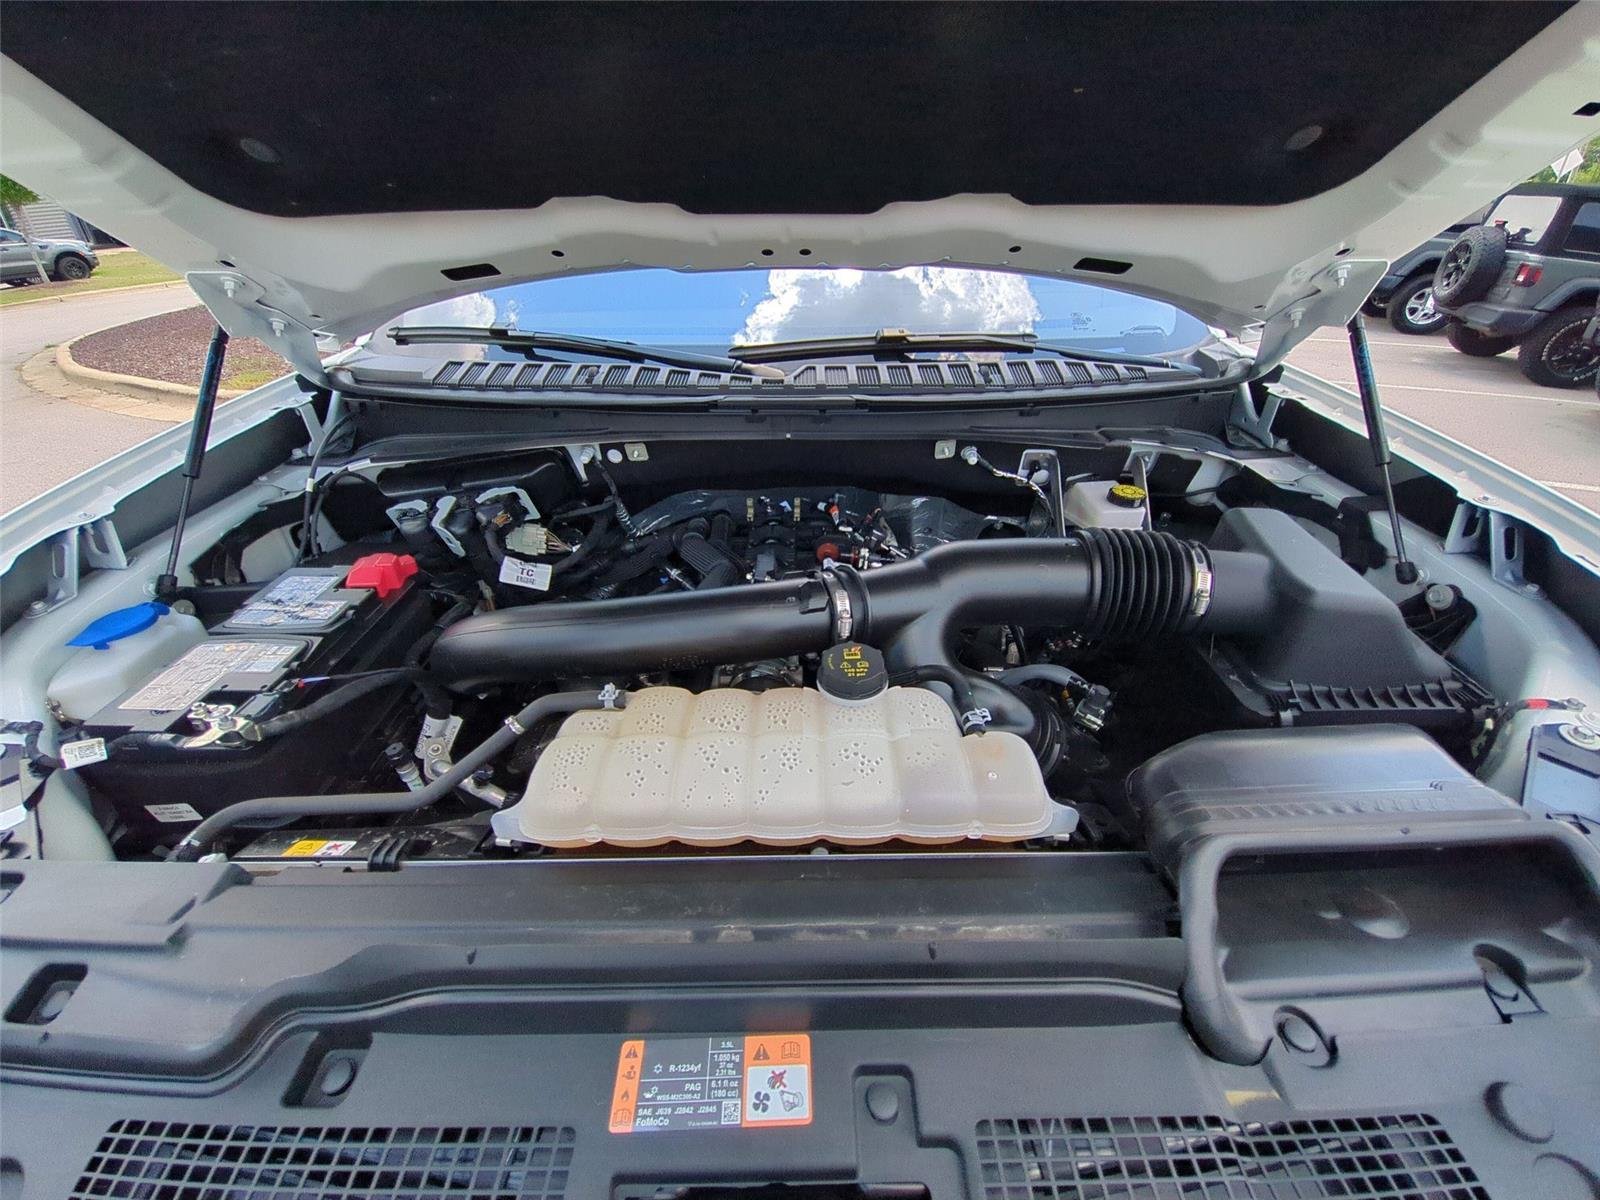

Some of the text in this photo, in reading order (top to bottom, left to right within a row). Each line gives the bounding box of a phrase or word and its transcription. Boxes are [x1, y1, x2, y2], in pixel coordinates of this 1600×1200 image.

[520, 567, 535, 577] TC
[731, 1053, 740, 1063] kg
[669, 1064, 702, 1073] R-1234yf
[684, 1083, 702, 1091] PAG
[723, 1080, 728, 1088] fl
[729, 1080, 739, 1088] oz
[727, 1089, 739, 1099] cc)
[638, 1108, 652, 1116] SAE
[636, 1117, 670, 1127] FoMoCo
